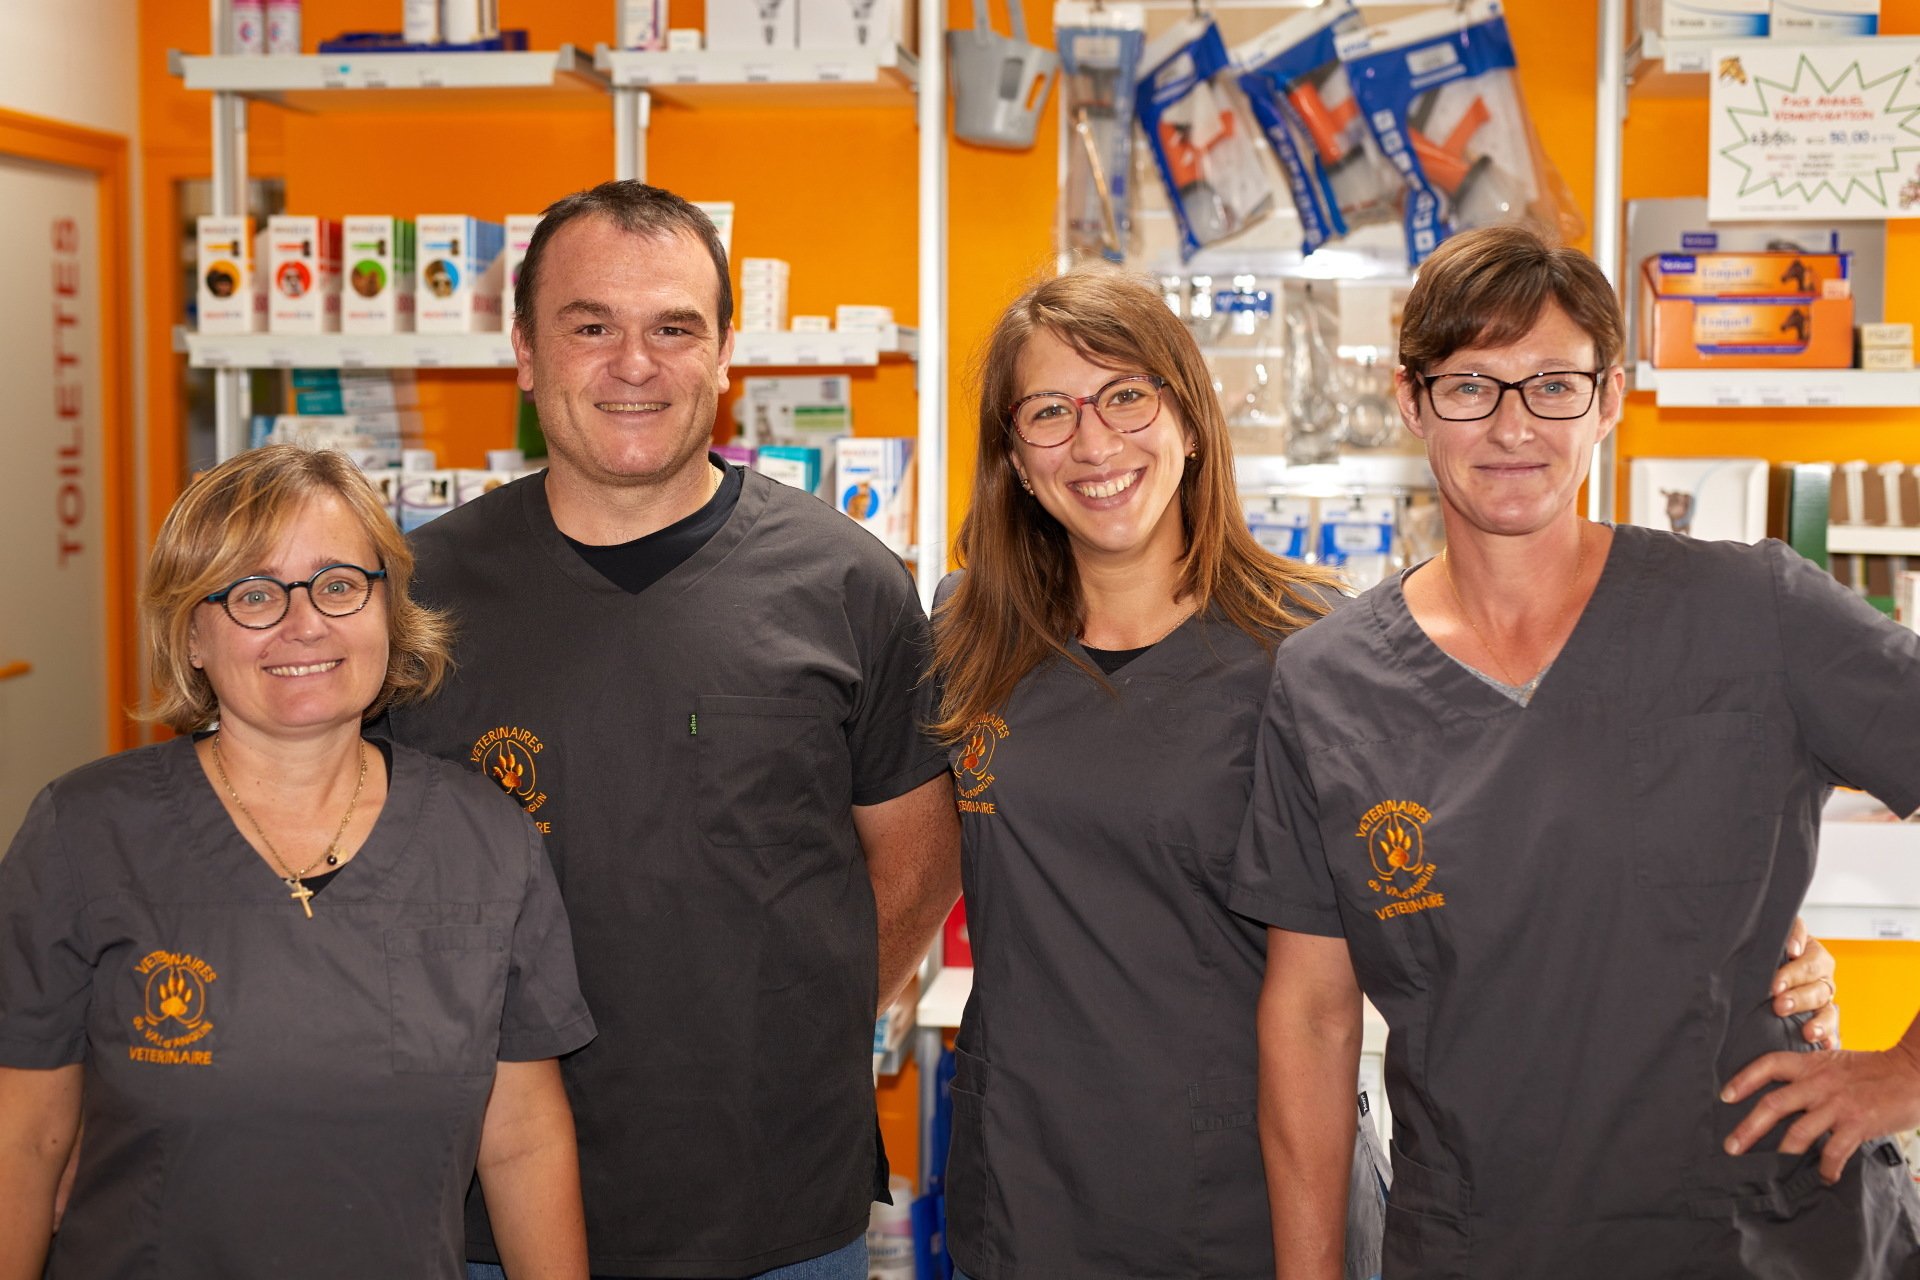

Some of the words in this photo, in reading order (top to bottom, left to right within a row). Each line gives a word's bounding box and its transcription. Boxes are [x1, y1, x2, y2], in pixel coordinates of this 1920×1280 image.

[51, 217, 86, 570] TOILETTES
[470, 726, 544, 763] VETERINAIRES
[1355, 799, 1433, 837] VETERINAIRES
[1375, 893, 1446, 920] VETERINAIRE
[134, 949, 217, 984] VETERINAIRES
[129, 1047, 212, 1065] VETERINAIRE
